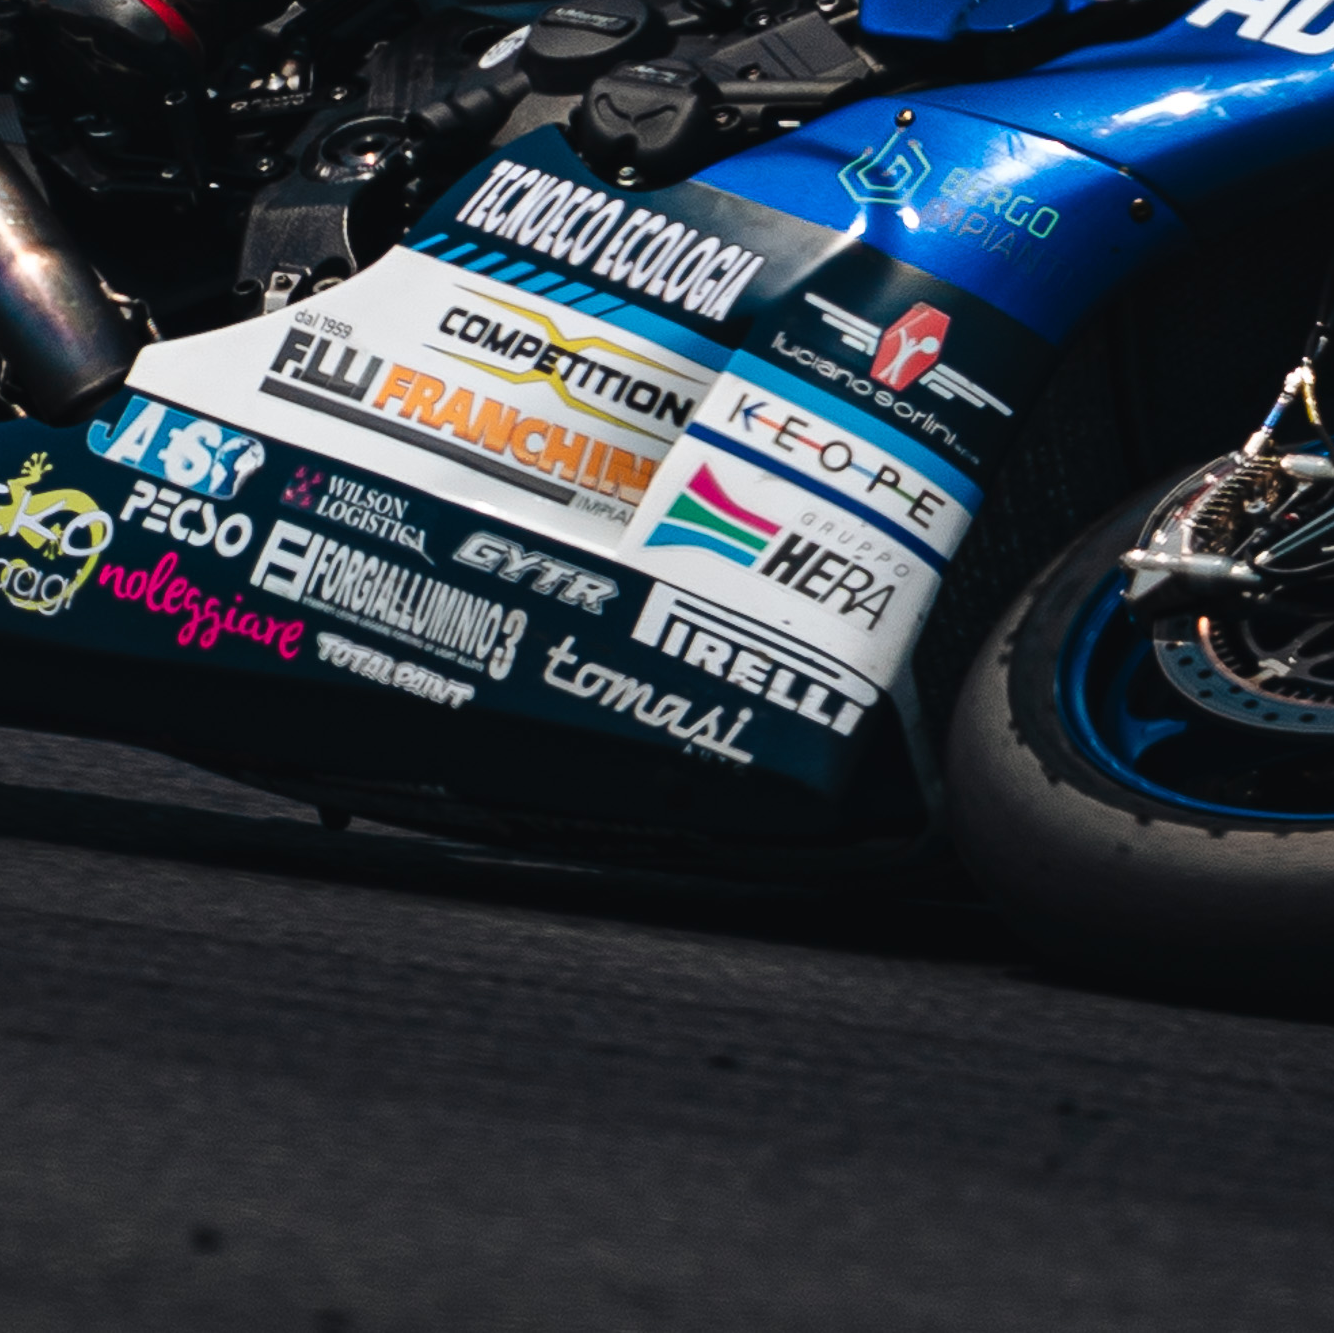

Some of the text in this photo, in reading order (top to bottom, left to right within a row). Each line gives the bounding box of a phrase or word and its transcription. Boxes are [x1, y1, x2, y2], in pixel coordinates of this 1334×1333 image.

[455, 159, 765, 321] TECNOECO ECOLOGIA
[939, 166, 1060, 239] BERGO
[294, 307, 354, 339] dal 1959
[438, 305, 696, 429] COMPETITION
[327, 474, 410, 520] WILSON
[728, 393, 946, 531] KEOPE
[315, 495, 436, 566] LOGISTICA
[452, 530, 620, 615] GYTR
[801, 511, 910, 579] GRUPPO
[99, 552, 305, 659] noleggiare
[761, 533, 897, 631] HERA
[543, 635, 754, 764] tomasi
[630, 580, 879, 737] PIRELLI
